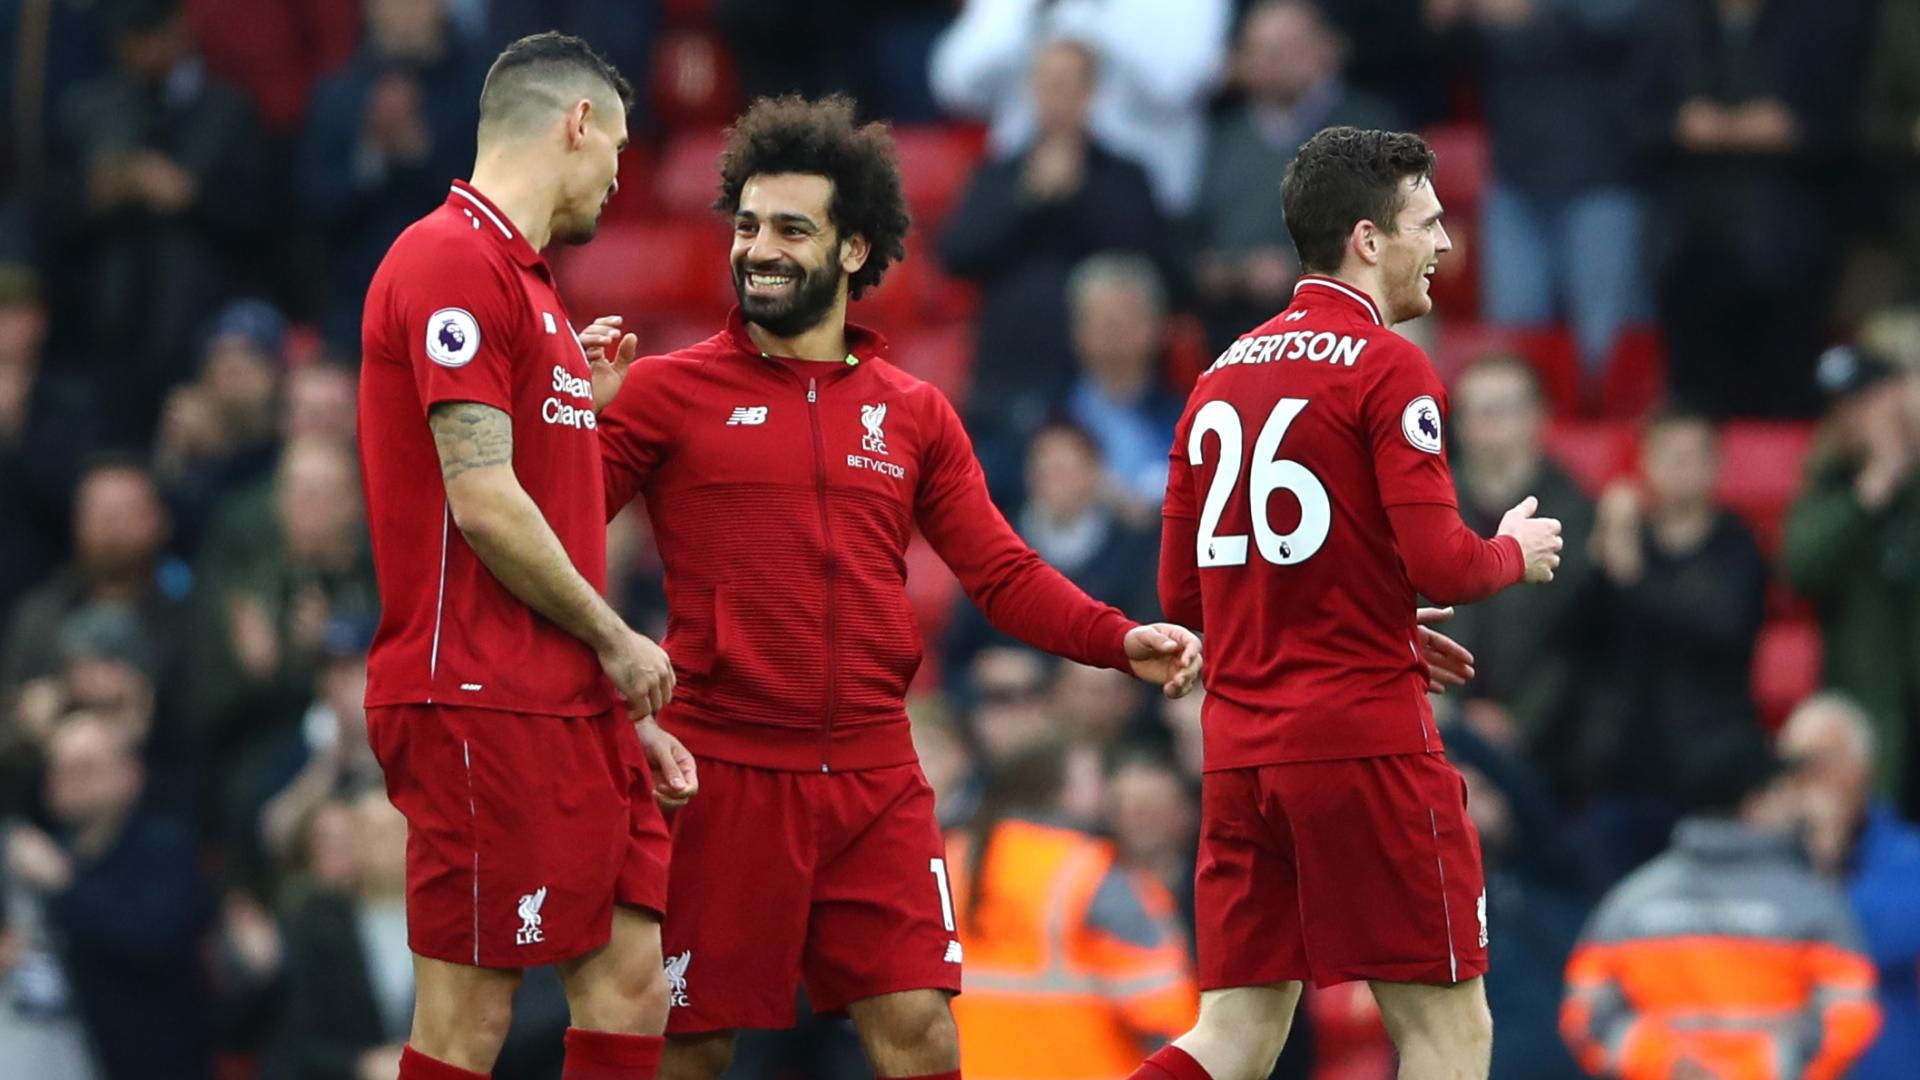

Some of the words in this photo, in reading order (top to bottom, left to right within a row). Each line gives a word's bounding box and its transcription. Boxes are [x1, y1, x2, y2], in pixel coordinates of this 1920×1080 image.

[1202, 331, 1367, 376] OBERTSON
[847, 454, 905, 480] BETVICTOR
[1188, 397, 1331, 568] 26
